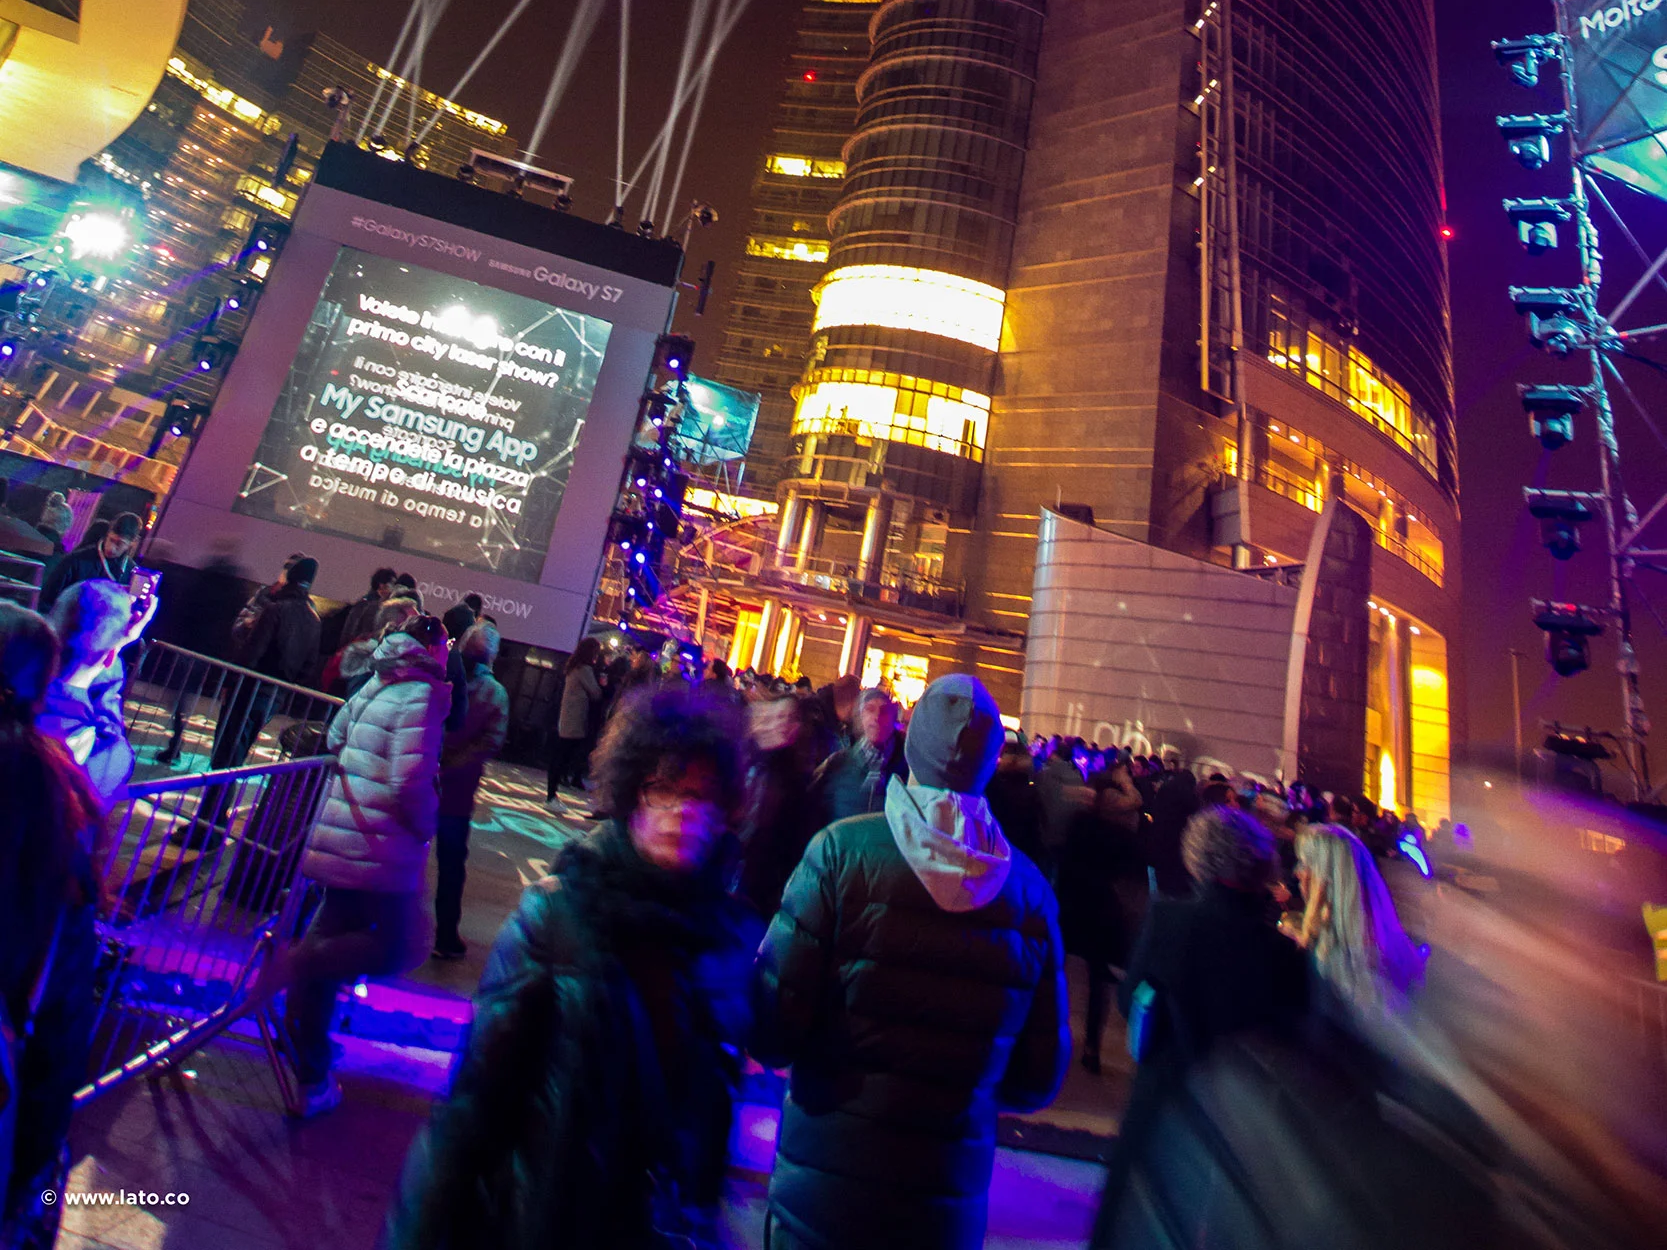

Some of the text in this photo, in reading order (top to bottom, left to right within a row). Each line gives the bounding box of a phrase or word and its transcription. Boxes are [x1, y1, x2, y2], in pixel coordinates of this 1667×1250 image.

[351, 216, 482, 262] #GalaxyS7SHOW
[488, 259, 624, 303] SAMSUNG Galaxy S7
[346, 318, 410, 346] primo
[410, 335, 449, 360] city
[498, 361, 559, 388] show?
[515, 342, 553, 366] con
[310, 417, 327, 434] e
[329, 421, 442, 464] accendete
[444, 448, 464, 471] la
[463, 456, 529, 488] piazza
[320, 382, 538, 467] My Samsung App
[300, 444, 319, 463] a
[325, 446, 405, 484] tempo
[439, 478, 522, 515] musica
